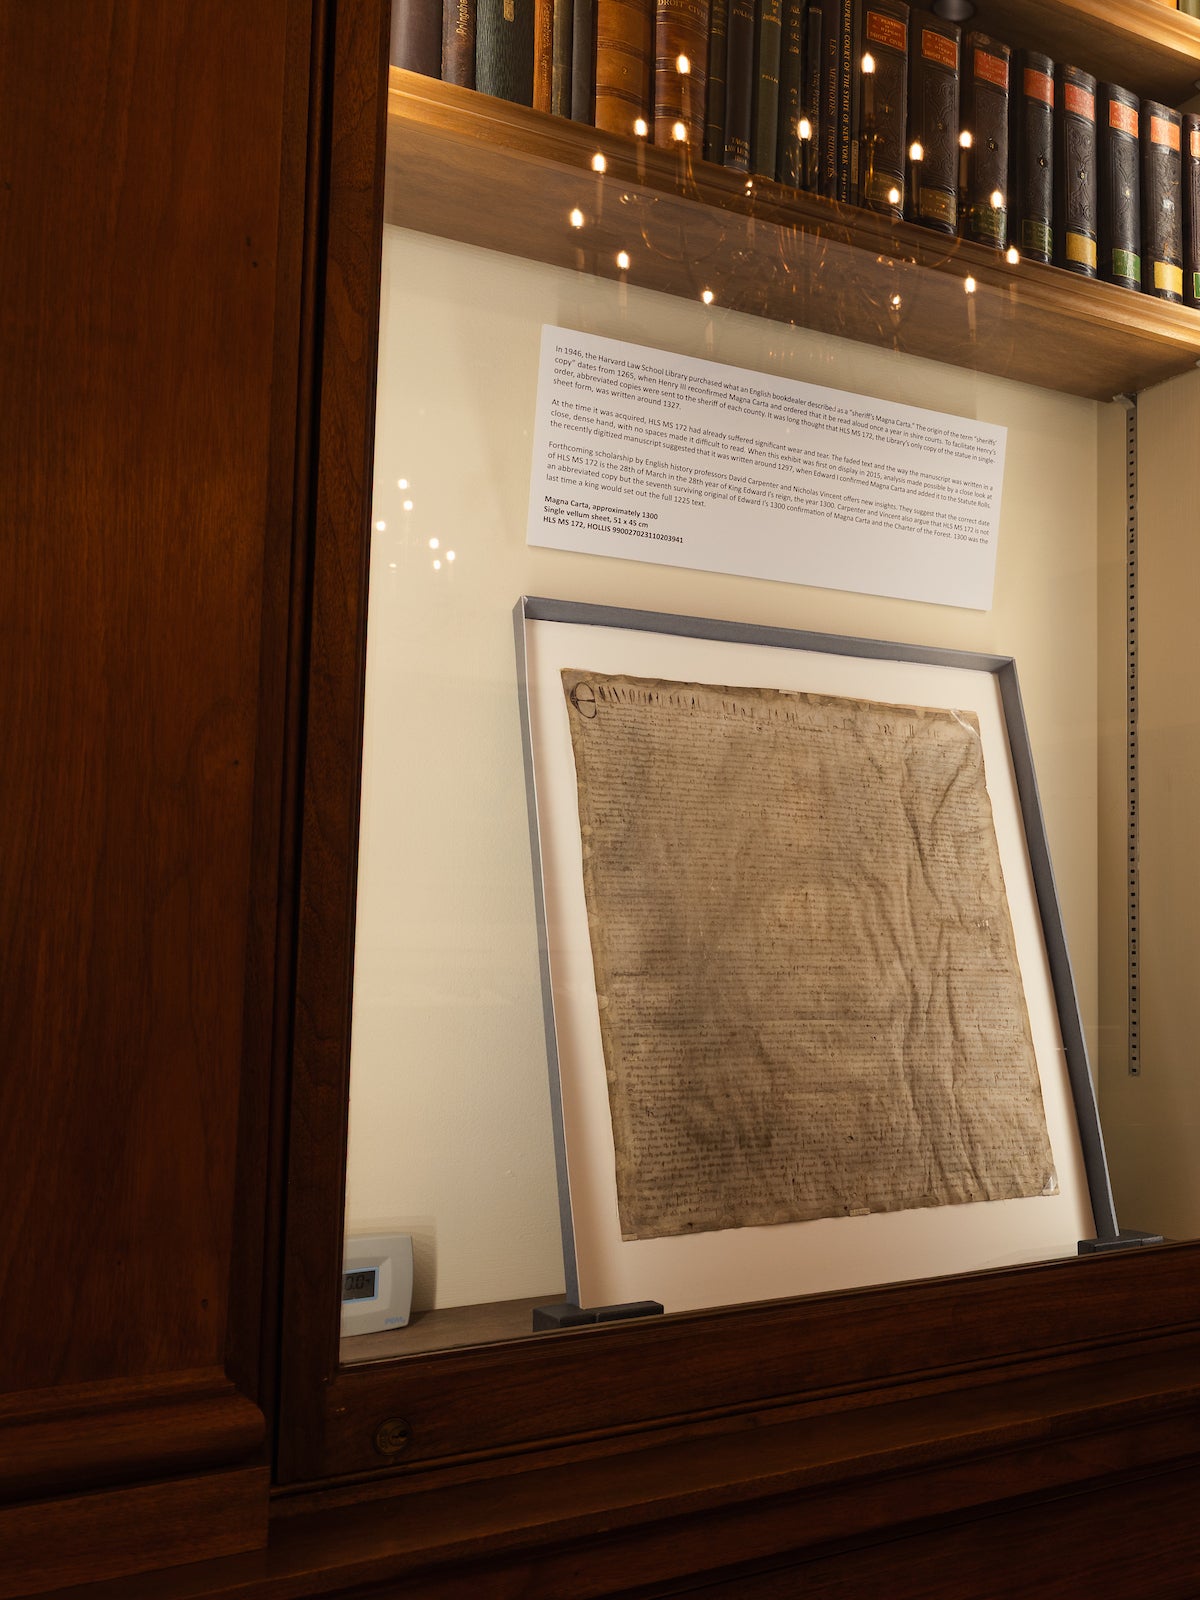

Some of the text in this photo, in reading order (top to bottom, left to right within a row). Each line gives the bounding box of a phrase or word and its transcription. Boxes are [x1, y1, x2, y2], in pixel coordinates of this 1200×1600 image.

[843, 34, 851, 60] COURT
[842, 61, 850, 73] OF
[842, 73, 850, 88] THE
[841, 114, 849, 124] OF
[840, 145, 848, 165] YORK
[553, 378, 573, 387] sheet
[610, 390, 635, 400] written
[636, 396, 661, 405] around
[555, 345, 562, 353] In
[584, 352, 597, 360] the
[598, 354, 625, 366] Harvard
[626, 361, 640, 369] Law
[641, 364, 664, 375] School
[664, 369, 688, 381] Library
[688, 375, 722, 387] purchased
[723, 382, 739, 391] what
[749, 387, 771, 398] English
[772, 392, 806, 405] bookdealer
[807, 400, 836, 412] described
[875, 415, 894, 424] Magna
[915, 423, 926, 431] The
[960, 433, 972, 441] term
[549, 420, 562, 428] the
[563, 423, 592, 434] recently
[593, 428, 622, 439] digitized
[623, 435, 661, 447] manuscript
[662, 442, 695, 453] suggested
[696, 448, 710, 456] that
[730, 455, 753, 464] written
[754, 460, 776, 468] around
[795, 467, 812, 475] when
[813, 470, 835, 479] Edward
[839, 476, 868, 486] confirmed
[870, 480, 889, 490] Magna
[890, 484, 905, 493] Carta
[917, 490, 935, 498] added
[957, 497, 976, 506] Statute
[545, 473, 559, 482] last
[560, 476, 577, 485] time
[584, 480, 599, 490] king
[600, 484, 622, 492] would
[648, 491, 660, 499] the
[661, 493, 672, 501] full
[674, 495, 690, 504] 1225
[548, 441, 593, 456] Forthcoming
[594, 450, 633, 463] scholarship
[635, 456, 644, 465] by
[644, 459, 668, 468] English
[669, 463, 693, 474] history
[693, 469, 727, 479] professors
[728, 474, 746, 482] David
[747, 477, 779, 488] Carpenter
[792, 486, 818, 495] Nicholas
[819, 490, 842, 500] Vincent
[842, 495, 859, 503] offers
[898, 505, 912, 513] They
[958, 516, 977, 524] correct
[544, 495, 658, 519] Magna Carta, approximately 1300
[557, 464, 600, 477] abbreviated
[601, 473, 618, 481] copy
[619, 474, 631, 483] but
[632, 477, 644, 485] the
[645, 481, 672, 489] seventh
[673, 485, 703, 496] surviving
[703, 490, 728, 499] original
[737, 495, 761, 505] Edward
[770, 501, 785, 509] 1300
[786, 505, 824, 516] confirmation
[833, 512, 854, 521] Magna
[854, 516, 870, 524] Carta
[894, 523, 915, 531] Charter
[542, 515, 556, 524] HLS
[570, 520, 585, 529] 172,
[587, 522, 611, 532] HOLLIS
[543, 506, 565, 515] Single
[565, 510, 589, 518] vellum
[590, 513, 612, 522] sheet,
